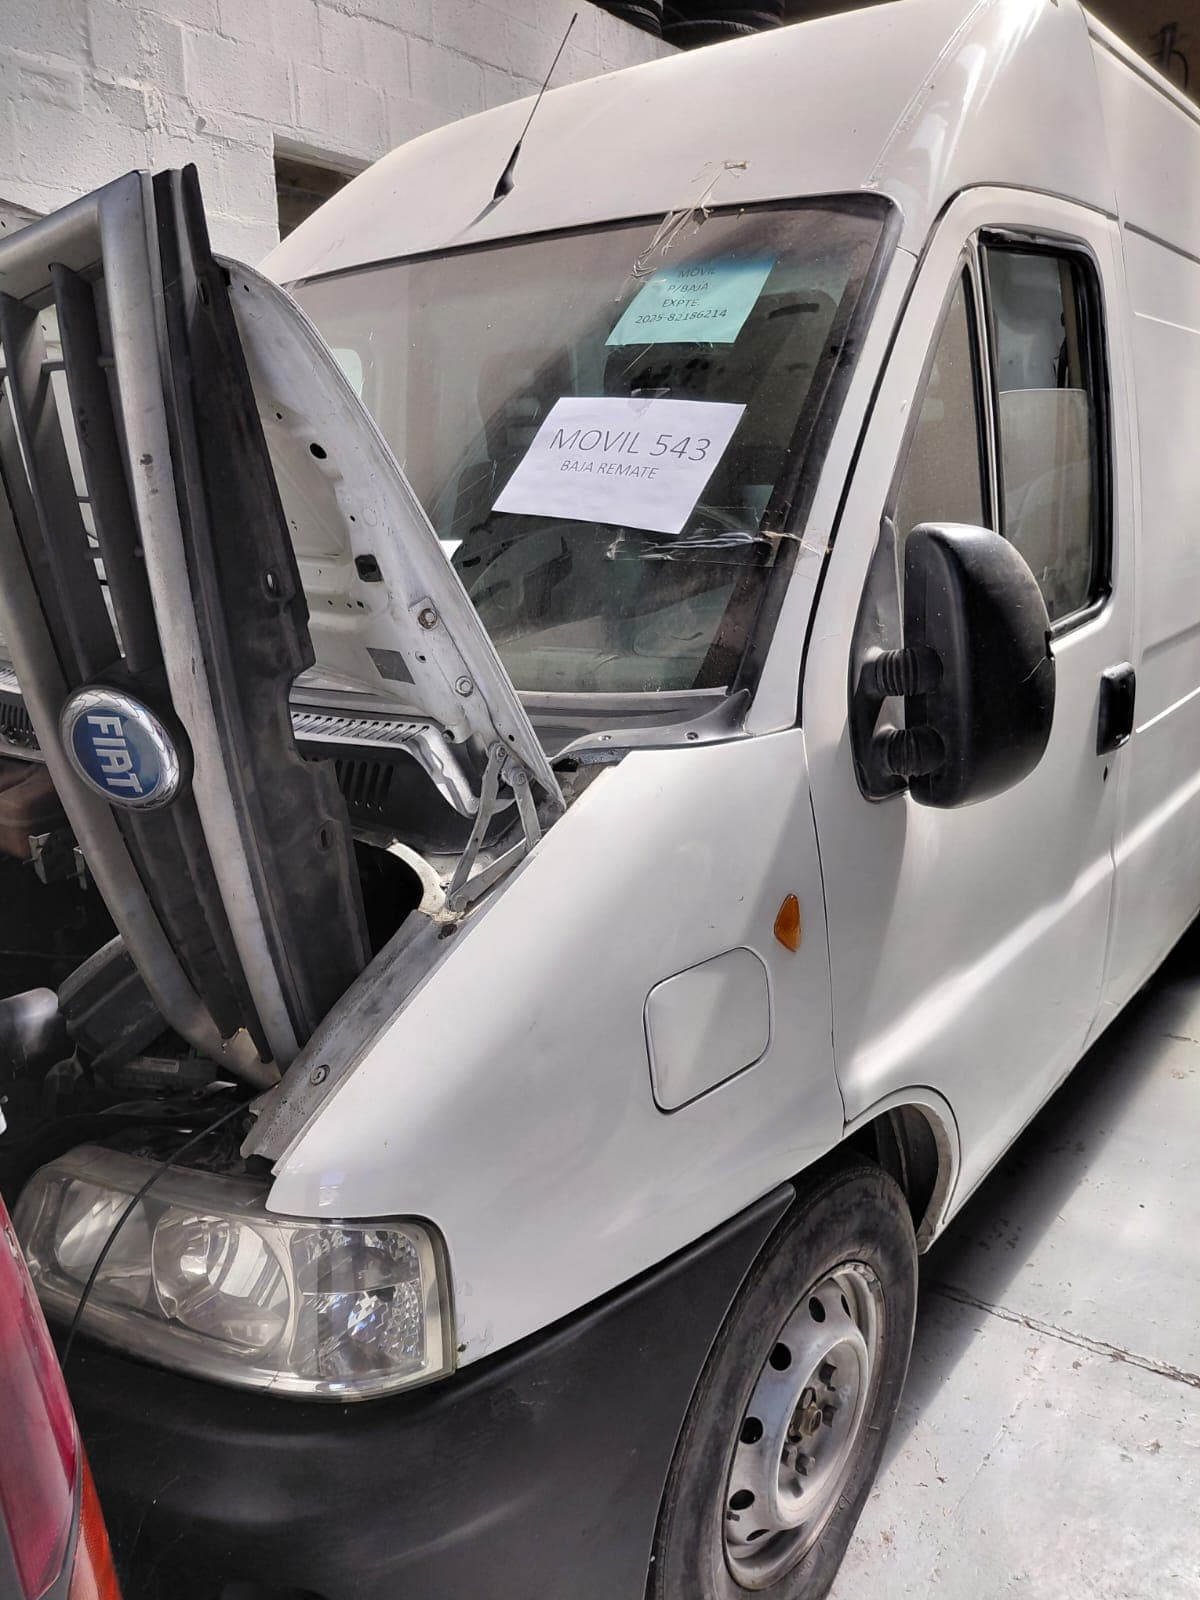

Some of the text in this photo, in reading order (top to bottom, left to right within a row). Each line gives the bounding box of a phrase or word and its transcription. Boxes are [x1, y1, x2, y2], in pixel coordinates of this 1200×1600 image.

[667, 282, 708, 293] P/BAJA
[550, 428, 711, 461] MOVIL 543
[560, 460, 659, 480] BAJA REMATE
[87, 715, 143, 793] FIAT
